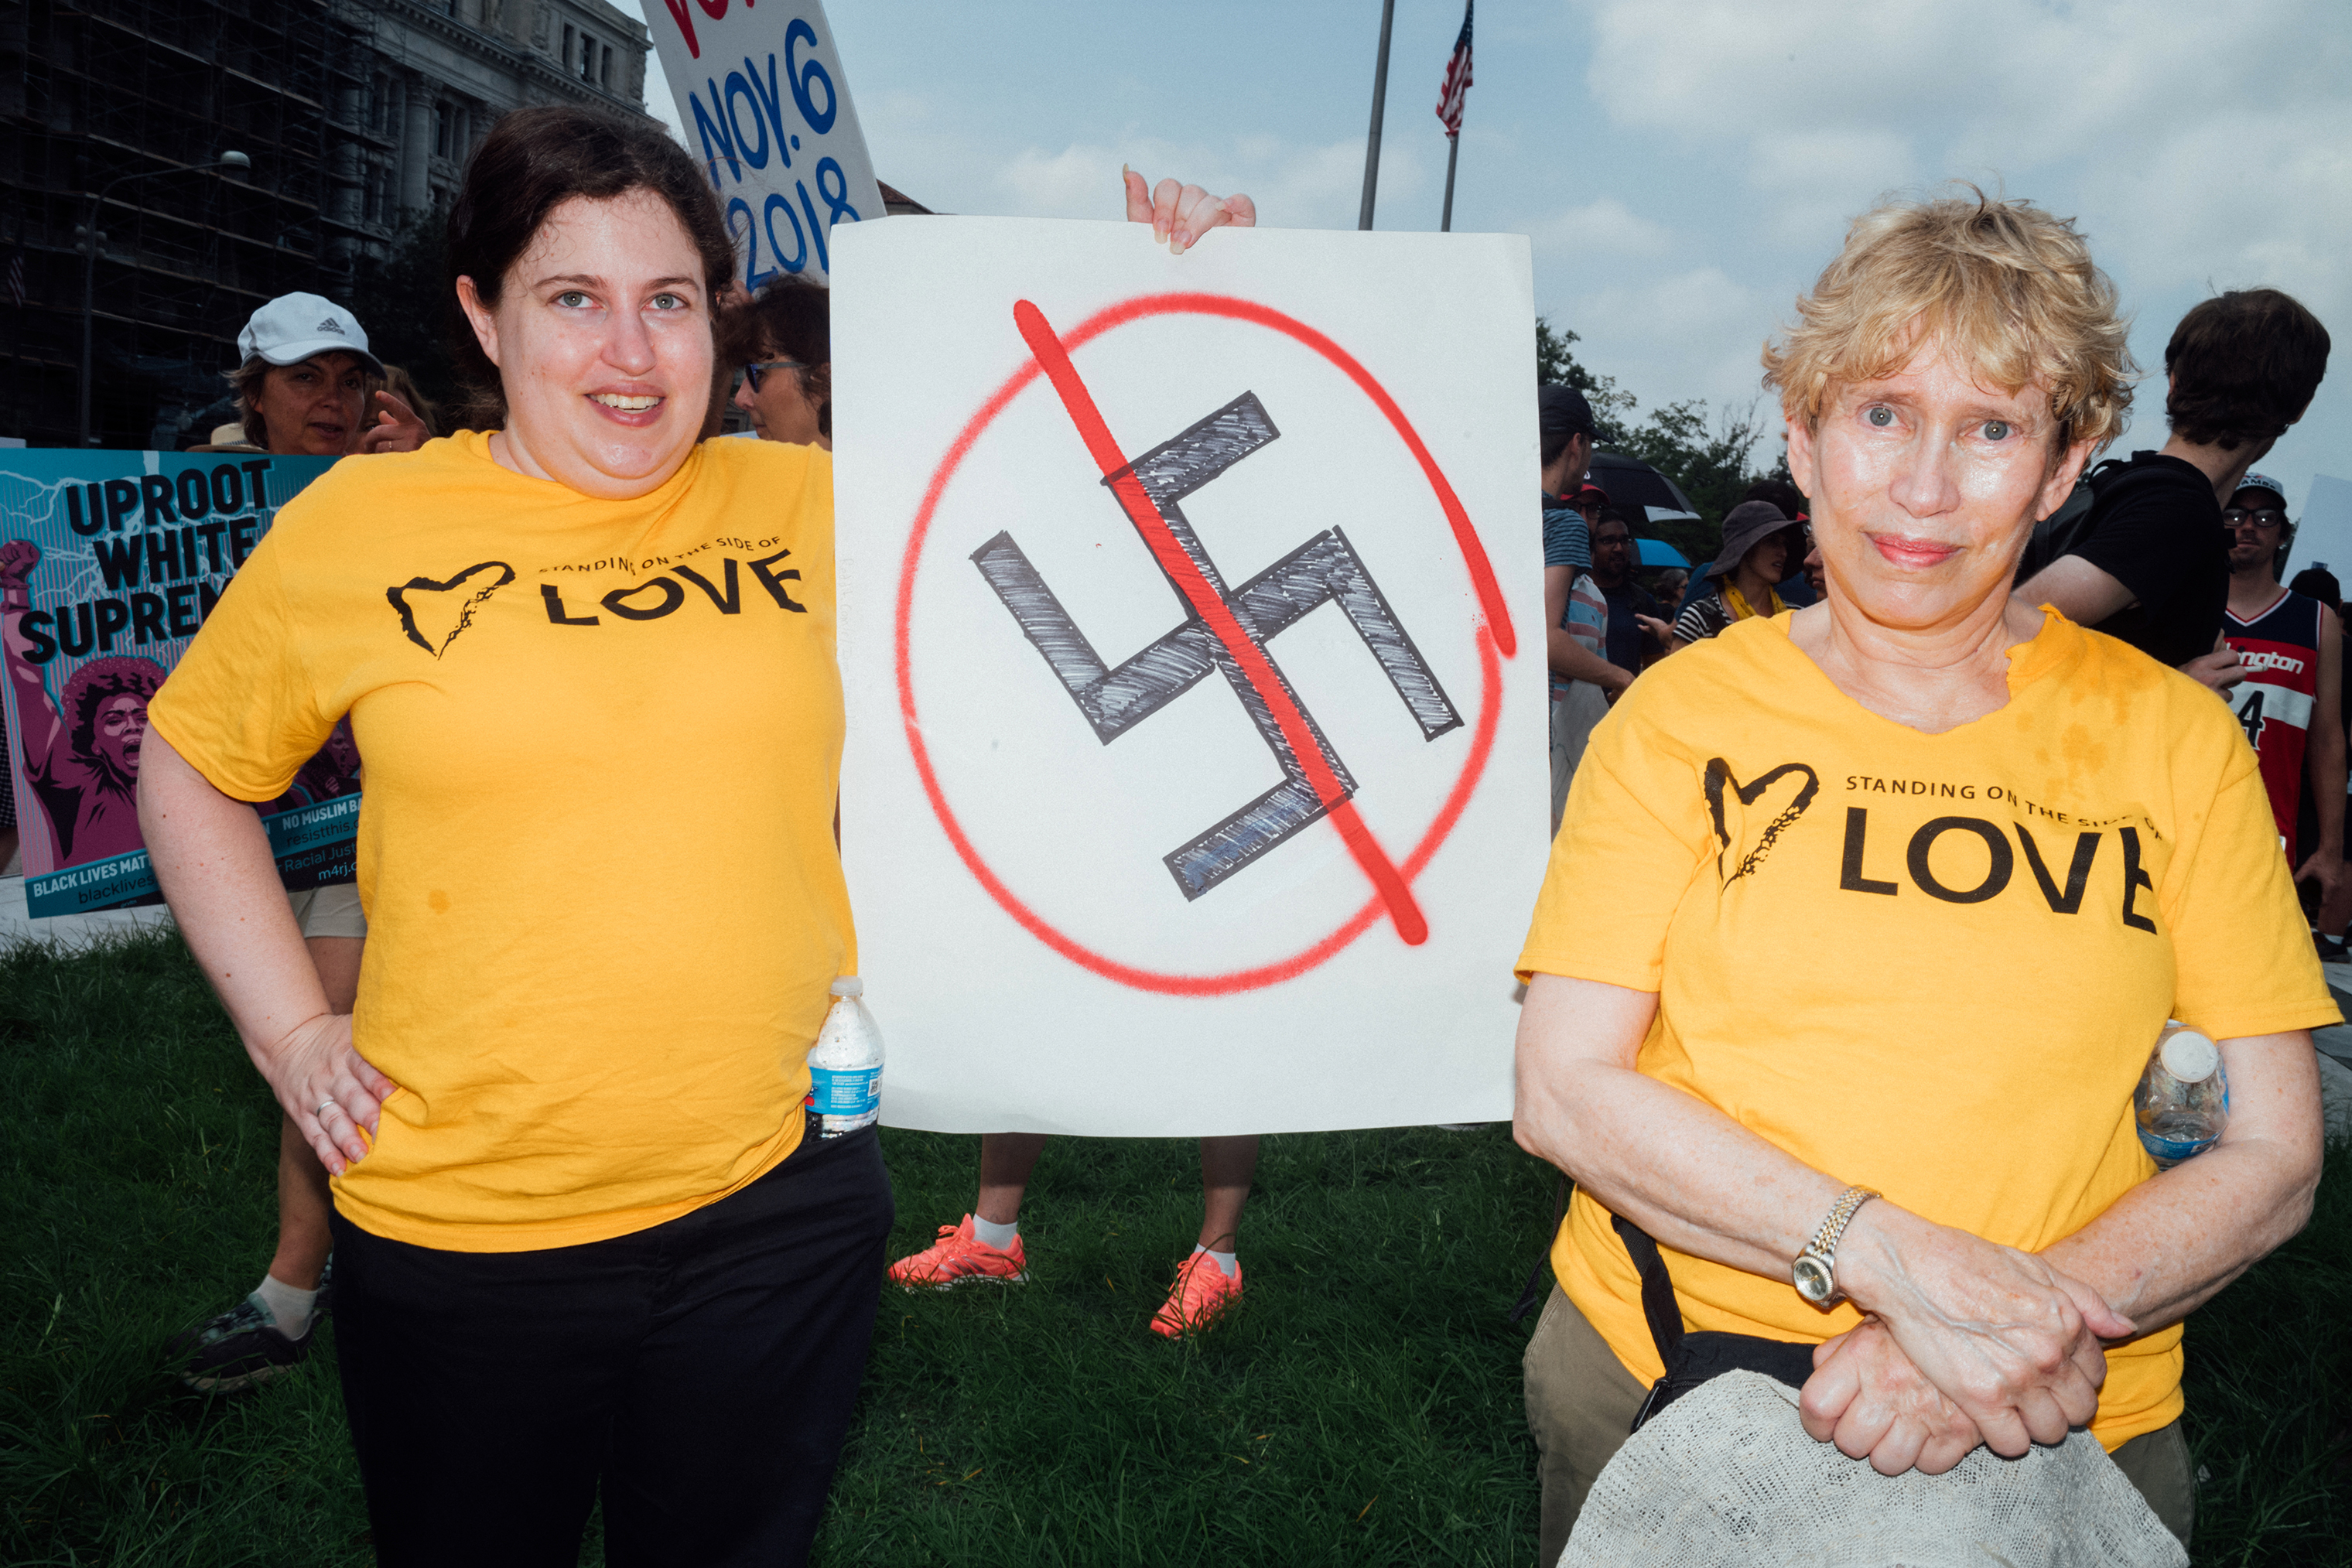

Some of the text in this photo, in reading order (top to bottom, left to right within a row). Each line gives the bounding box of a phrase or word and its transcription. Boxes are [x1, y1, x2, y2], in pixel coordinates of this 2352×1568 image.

[727, 157, 861, 294] 2018
[66, 459, 271, 536] UPROOT
[92, 518, 259, 590] WHITE
[642, 556, 669, 569] ON
[675, 543, 711, 559] THE
[716, 538, 754, 551] SIDE
[759, 536, 780, 548] OF
[542, 548, 808, 626] LOVE
[282, 815, 299, 831] NO
[302, 801, 347, 825] MUSLIM
[1846, 775, 1975, 800] STANDING
[1987, 785, 2017, 808] ON
[2025, 800, 2069, 825] THE
[33, 873, 78, 897] BLACK
[80, 863, 118, 886] LIVES
[285, 850, 326, 873] Racial
[1840, 806, 2158, 935] LOVE
[78, 874, 156, 905] blacklives
